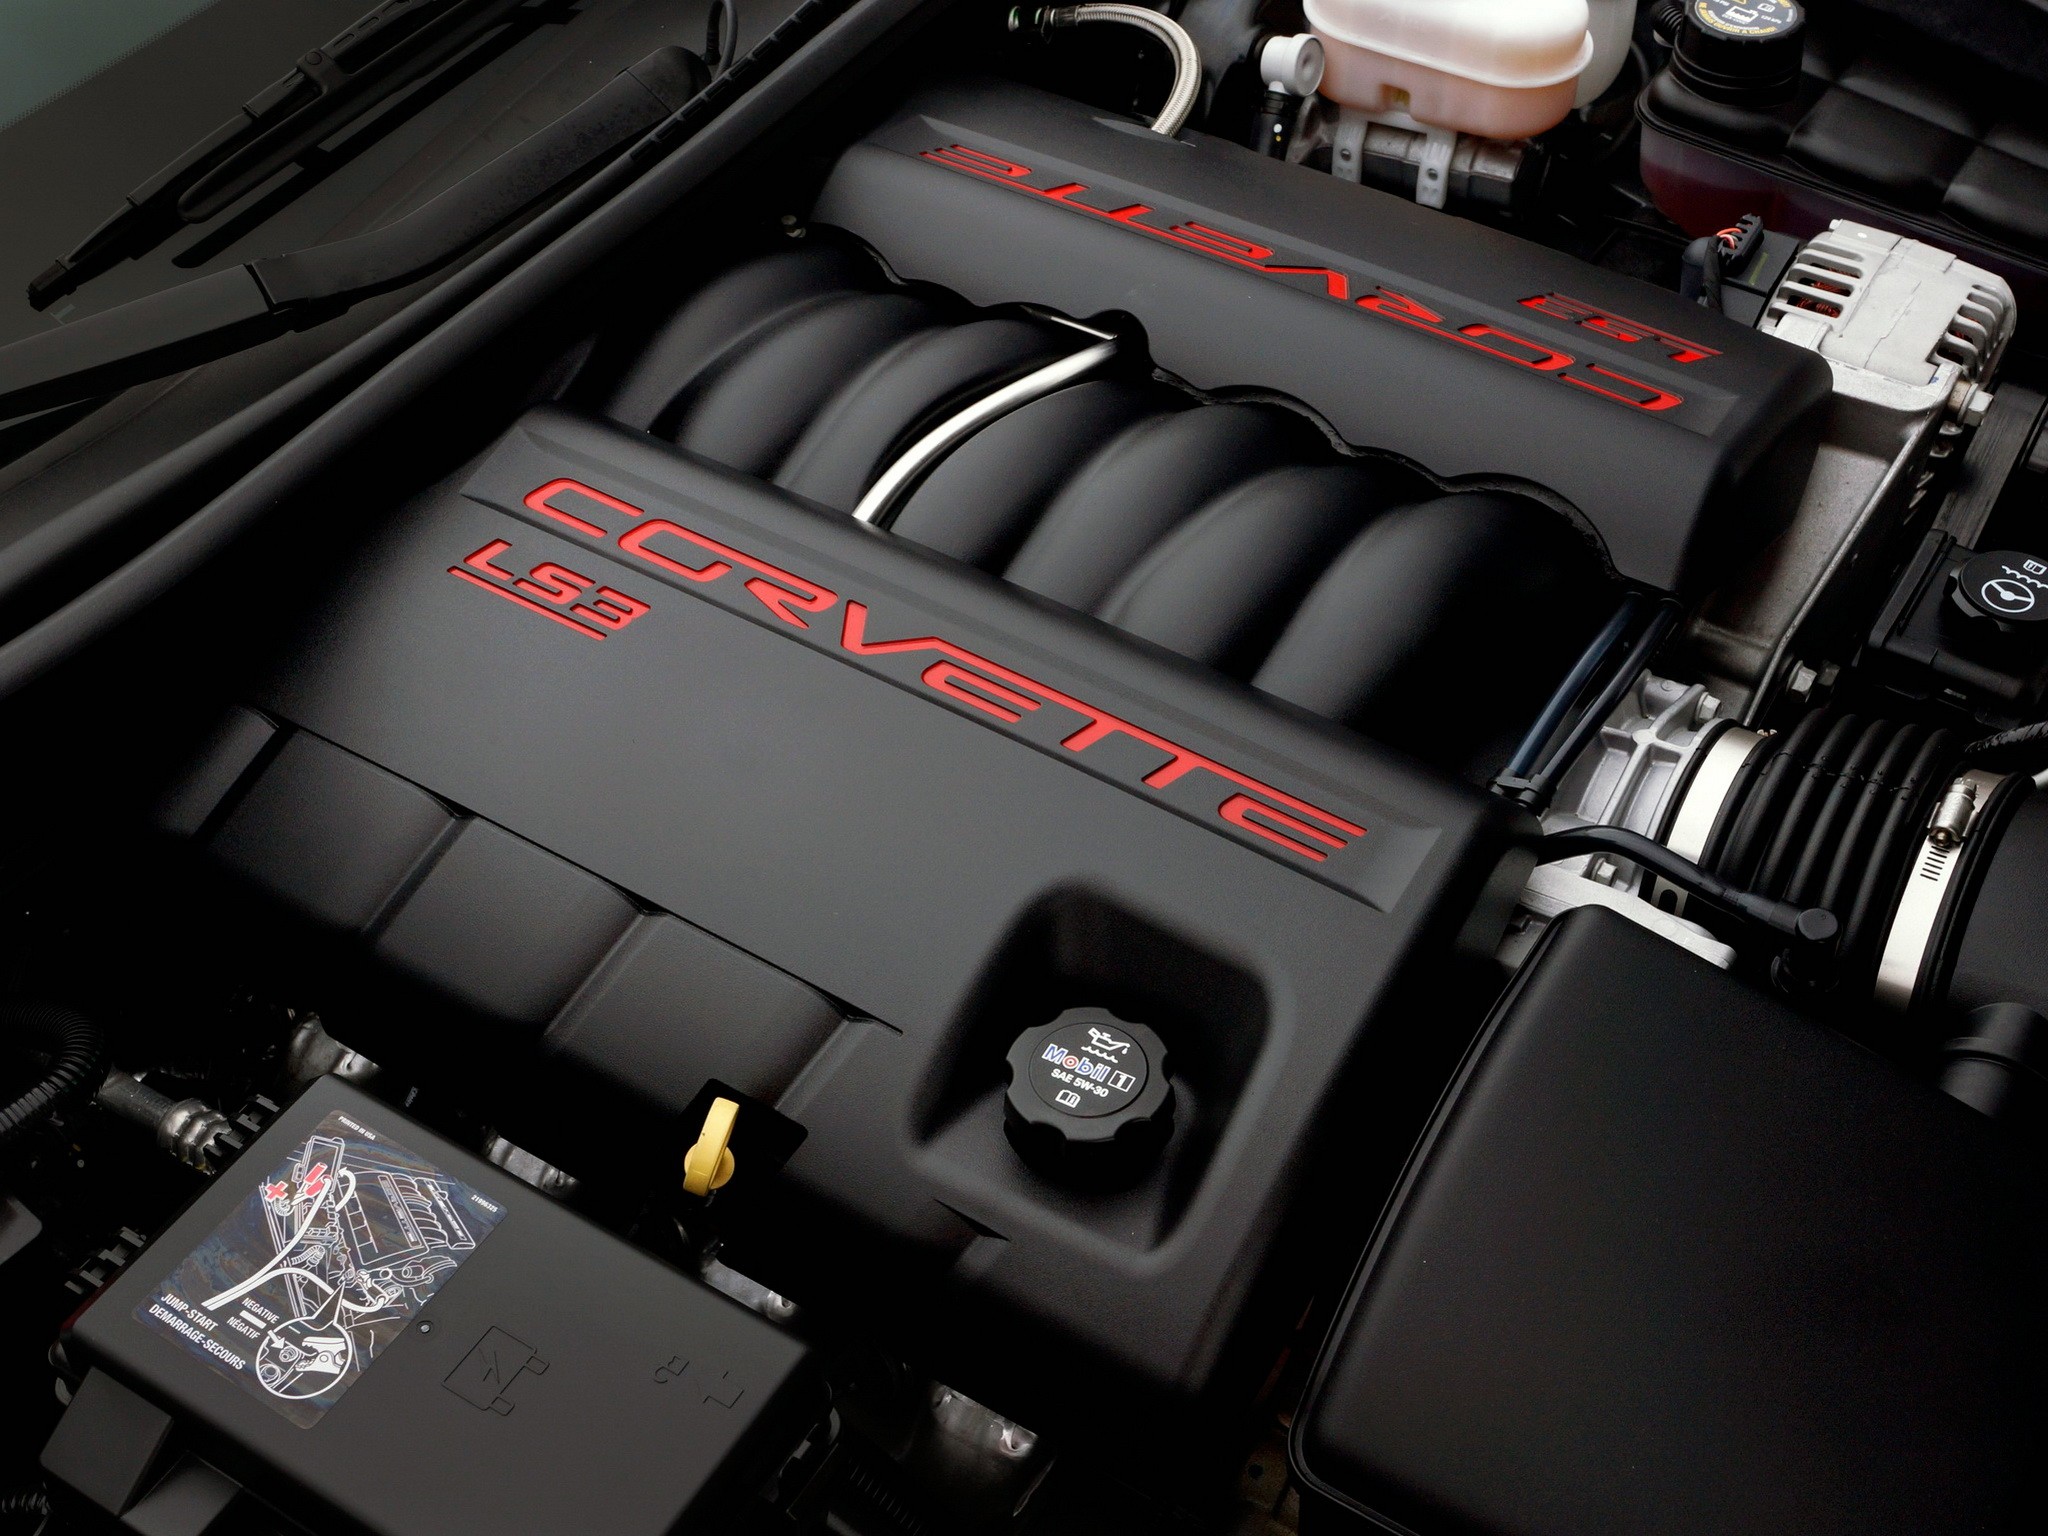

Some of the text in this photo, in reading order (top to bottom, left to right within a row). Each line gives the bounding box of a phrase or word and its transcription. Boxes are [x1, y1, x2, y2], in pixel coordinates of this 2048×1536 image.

[920, 144, 1684, 412] CORVETTE
[1518, 293, 1722, 366] LS3
[462, 538, 652, 632] LS3
[522, 477, 1368, 863] CORVETTE
[1041, 1043, 1111, 1082] Mobil
[1051, 1068, 1109, 1098] SAE 5W-30
[148, 1304, 247, 1371] DEMARRAGE-SECOURS
[160, 1293, 219, 1332] JUMP-START
[241, 1297, 280, 1324] NEGATIVE
